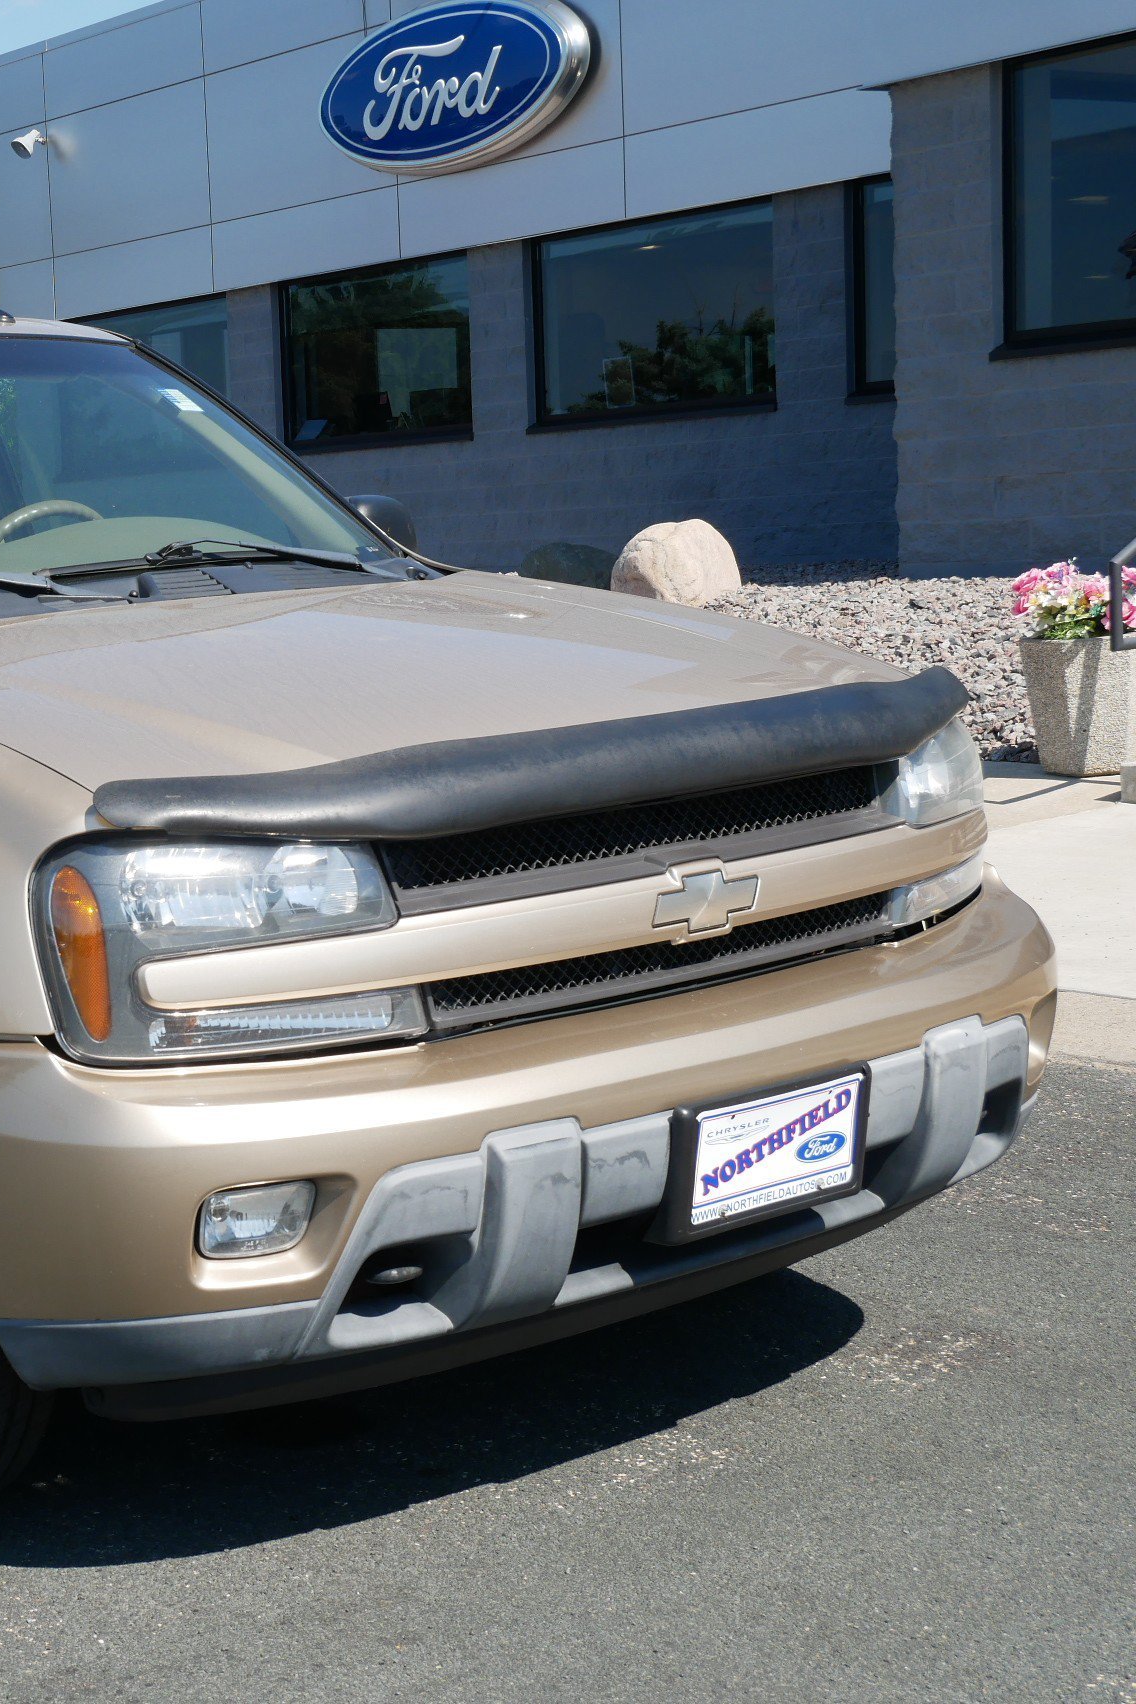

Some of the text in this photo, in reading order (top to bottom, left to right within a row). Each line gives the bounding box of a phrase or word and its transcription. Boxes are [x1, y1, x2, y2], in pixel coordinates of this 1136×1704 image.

[363, 34, 503, 141] Ford
[700, 1087, 852, 1197] NORTHFIELD
[706, 1117, 771, 1139] CHRYSLER
[804, 1135, 838, 1159] Ford
[690, 1171, 848, 1224] WWWNORTHFIELDAUTOSCOM
